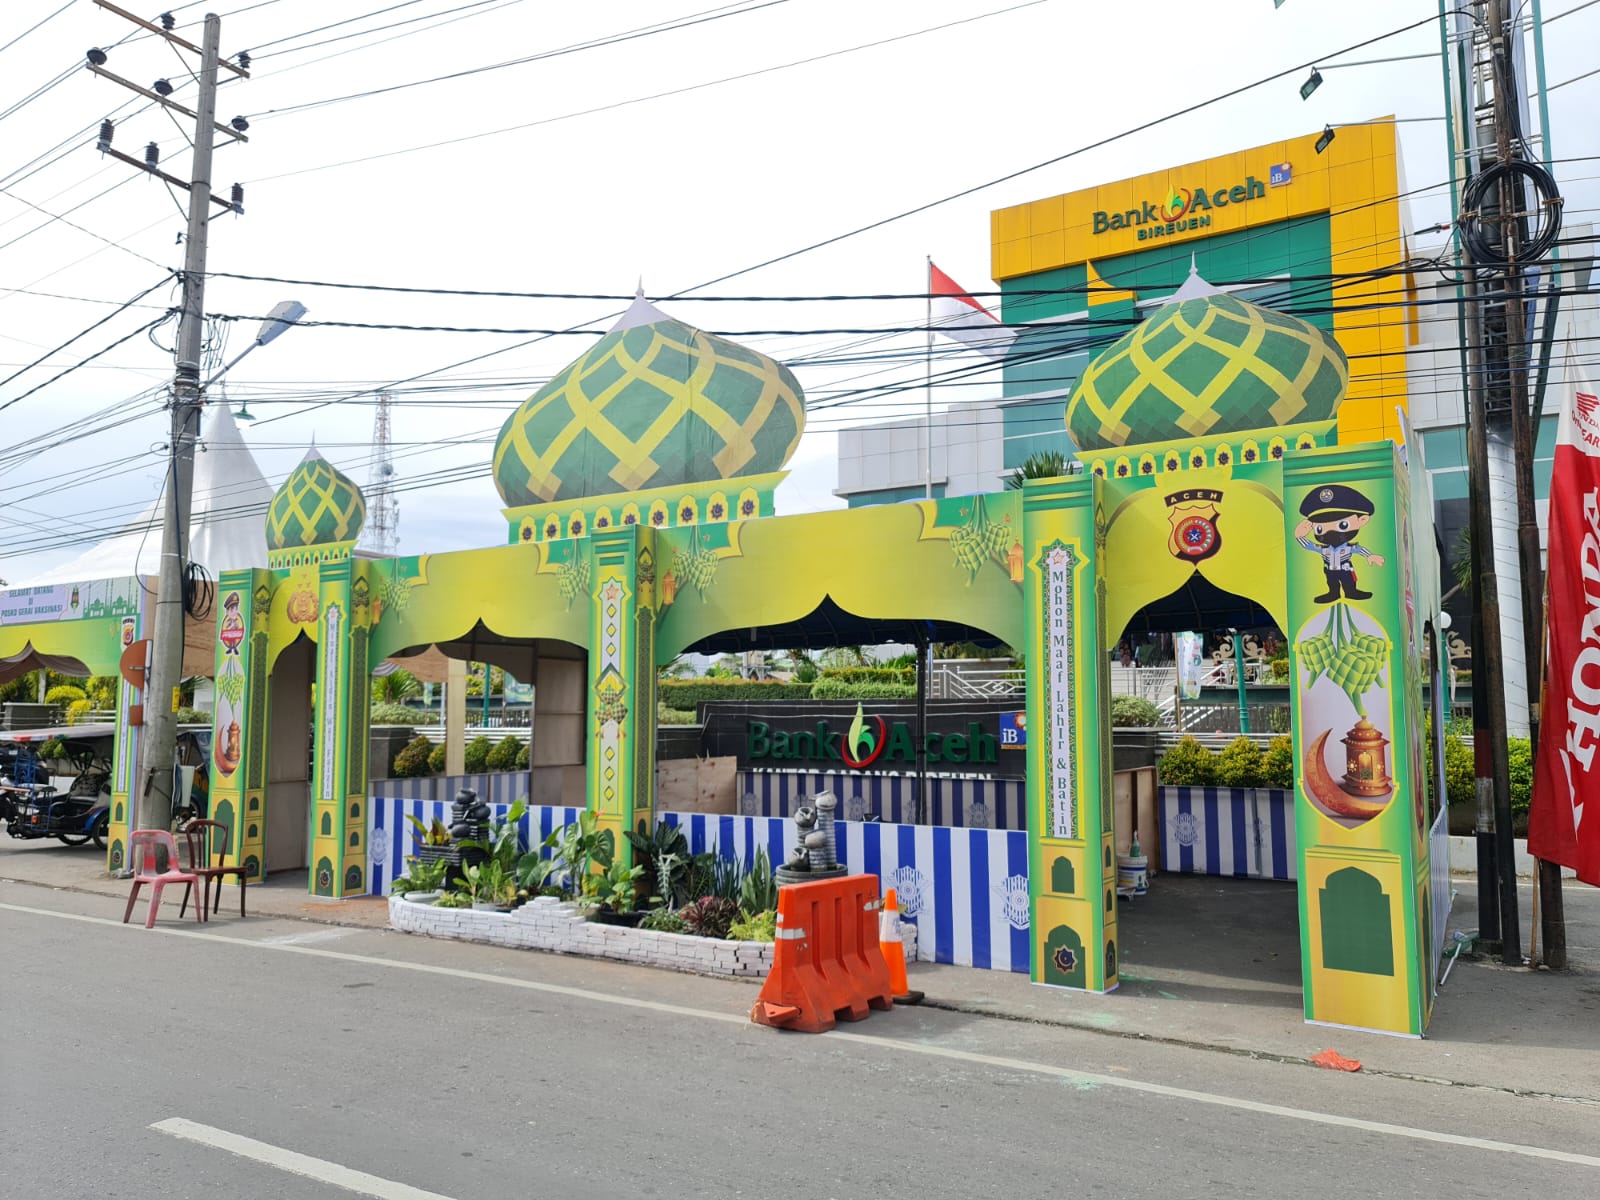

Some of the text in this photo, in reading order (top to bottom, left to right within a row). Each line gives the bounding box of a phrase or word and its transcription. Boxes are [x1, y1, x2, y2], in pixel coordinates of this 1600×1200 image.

[1093, 176, 1265, 234] Bank Aceh
[1137, 214, 1211, 240] BIREUEN
[1171, 491, 1217, 503] ACEH
[1052, 571, 1064, 627] Mohon
[1053, 635, 1065, 683] Maaf
[749, 720, 998, 764] Bank Aceh
[1003, 728, 1018, 743] iB
[1056, 757, 1067, 770] &
[1057, 777, 1067, 835] Batin
